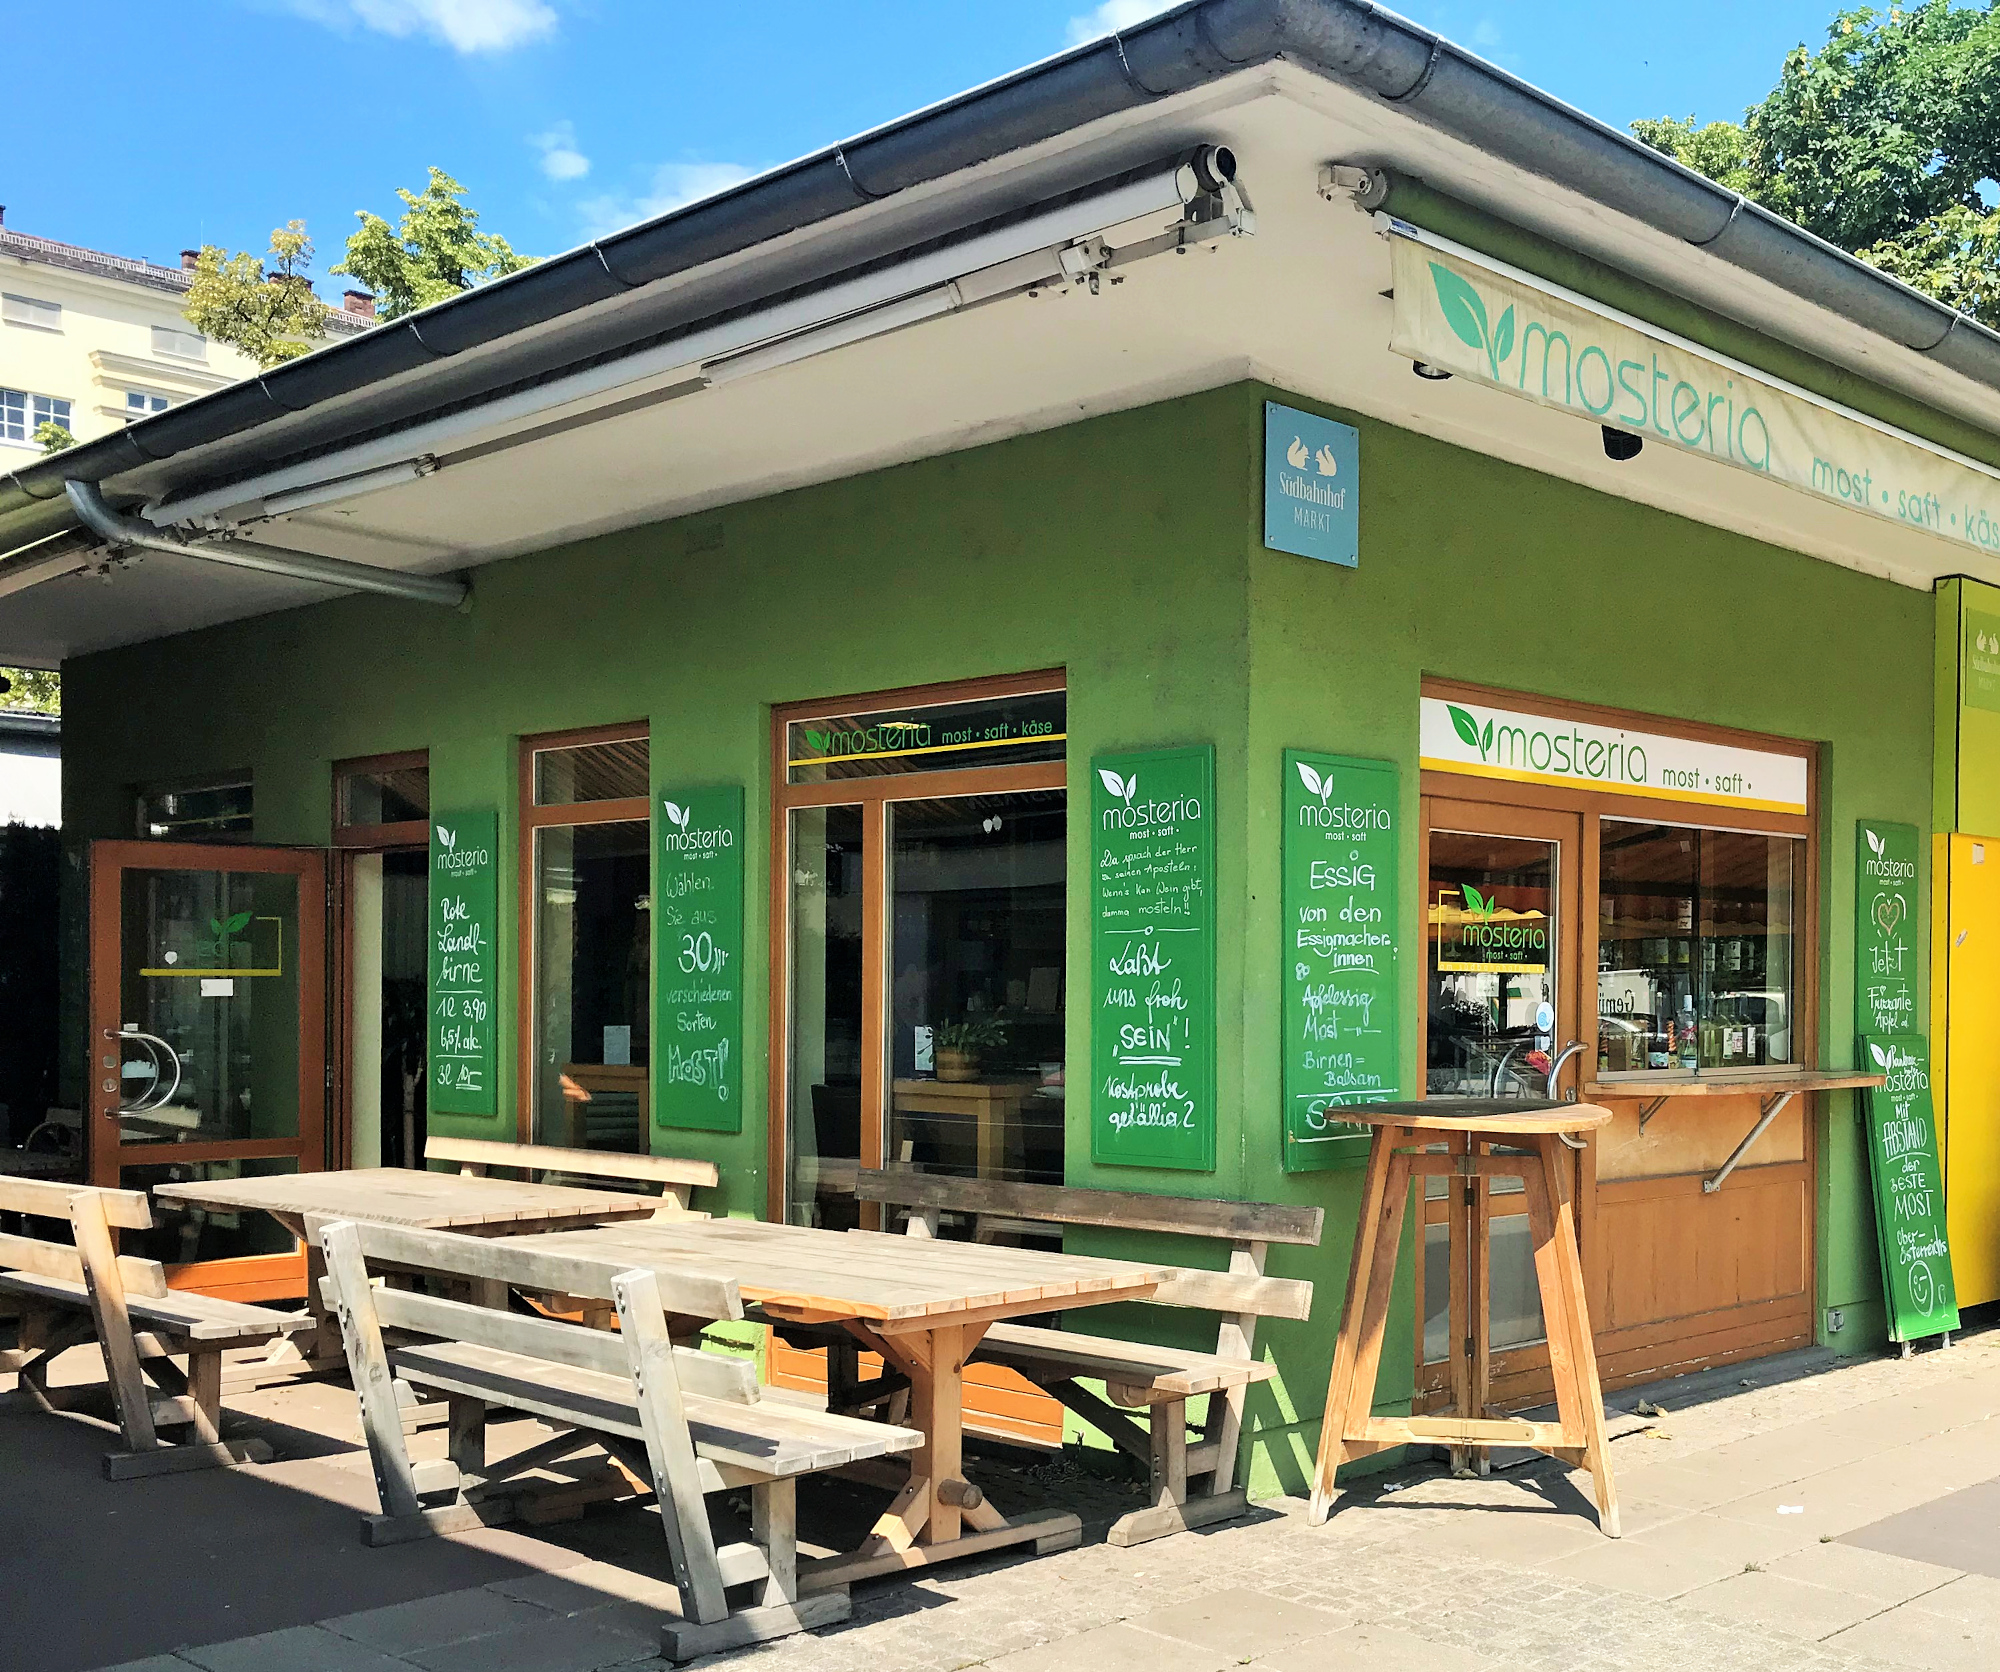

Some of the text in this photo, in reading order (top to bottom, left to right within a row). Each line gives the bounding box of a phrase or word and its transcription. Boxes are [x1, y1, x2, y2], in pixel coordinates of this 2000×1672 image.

[1519, 321, 1770, 472] mosteria
[1812, 456, 1873, 506] most
[1898, 489, 1941, 529] saft
[1279, 471, 1346, 511] Südbahnhof
[1294, 506, 1331, 533] MARKT
[831, 717, 1054, 756] mosteria most saft käse
[1497, 725, 1743, 794] mosteria most saft
[1103, 793, 1201, 831] mosteria
[1300, 803, 1391, 830] mosteria
[666, 824, 733, 852] mosteria
[1130, 825, 1174, 840] most saft
[1325, 831, 1367, 842] most saft
[437, 845, 488, 870] mosteria
[683, 850, 714, 860] most saft
[1100, 842, 1198, 869] Da sprach der Herr
[1866, 858, 1915, 878] mosteria
[1114, 868, 1142, 880] seinen
[1156, 881, 1179, 895] Wein
[440, 895, 470, 922] Rote
[666, 905, 717, 926] Sie aus
[1339, 895, 1382, 923] den
[1462, 922, 1546, 950] mosteria
[1109, 940, 1172, 977] Laßt
[1333, 948, 1374, 968] innen
[1486, 950, 1523, 961] most saft
[1869, 937, 1909, 976] Jetzt
[666, 977, 732, 1004] verschiedenen
[1103, 977, 1188, 1025] uns froh
[1302, 983, 1375, 1027] Apfelessig
[676, 1010, 717, 1032] Sorten
[1303, 1010, 1342, 1042] Most
[1875, 1011, 1898, 1036] Apfel
[1102, 1070, 1189, 1101] Kostprobe
[1324, 1069, 1381, 1087] Balsam
[1895, 1101, 1910, 1119] Mit
[1882, 1116, 1928, 1159] ABSTAND
[1901, 1155, 1920, 1173] der
[1890, 1173, 1926, 1193] BESTE
[1894, 1189, 1934, 1222] MOST
